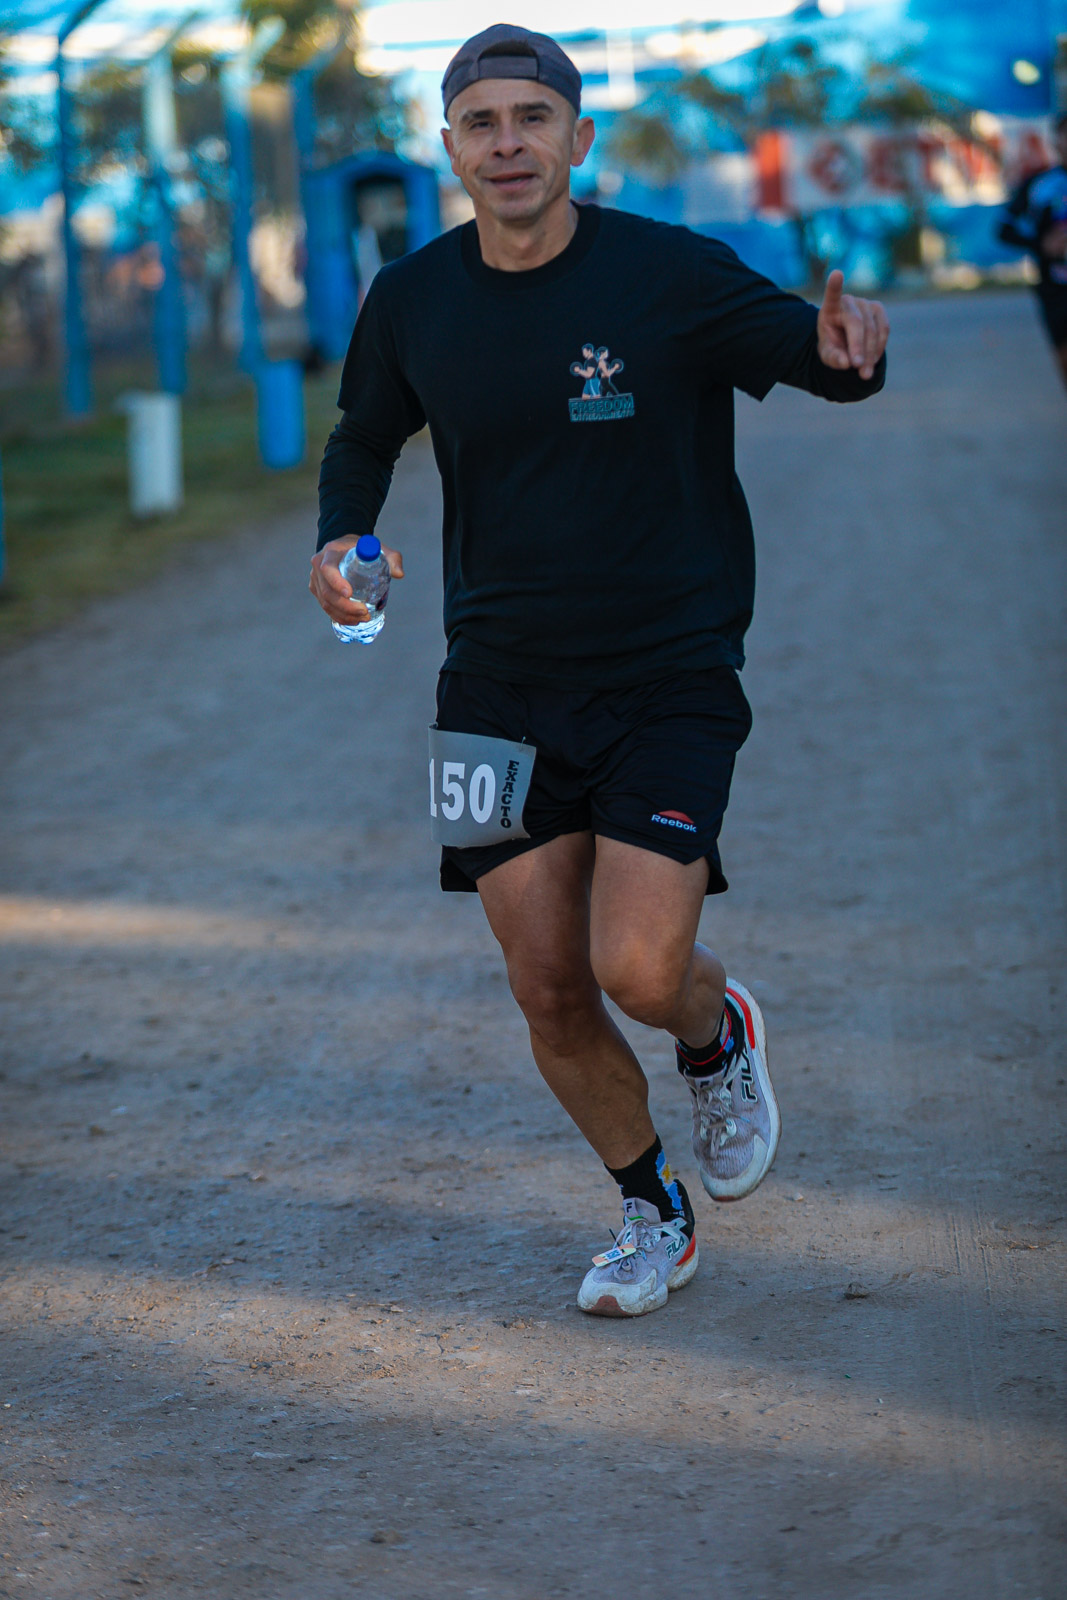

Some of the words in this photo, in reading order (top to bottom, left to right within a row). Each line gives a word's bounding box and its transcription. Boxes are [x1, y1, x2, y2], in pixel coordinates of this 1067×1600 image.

[570, 394, 634, 414] FREEDOM
[500, 759, 520, 829] EXACTO
[651, 813, 697, 833] Reebok
[665, 1235, 686, 1260] FILA
